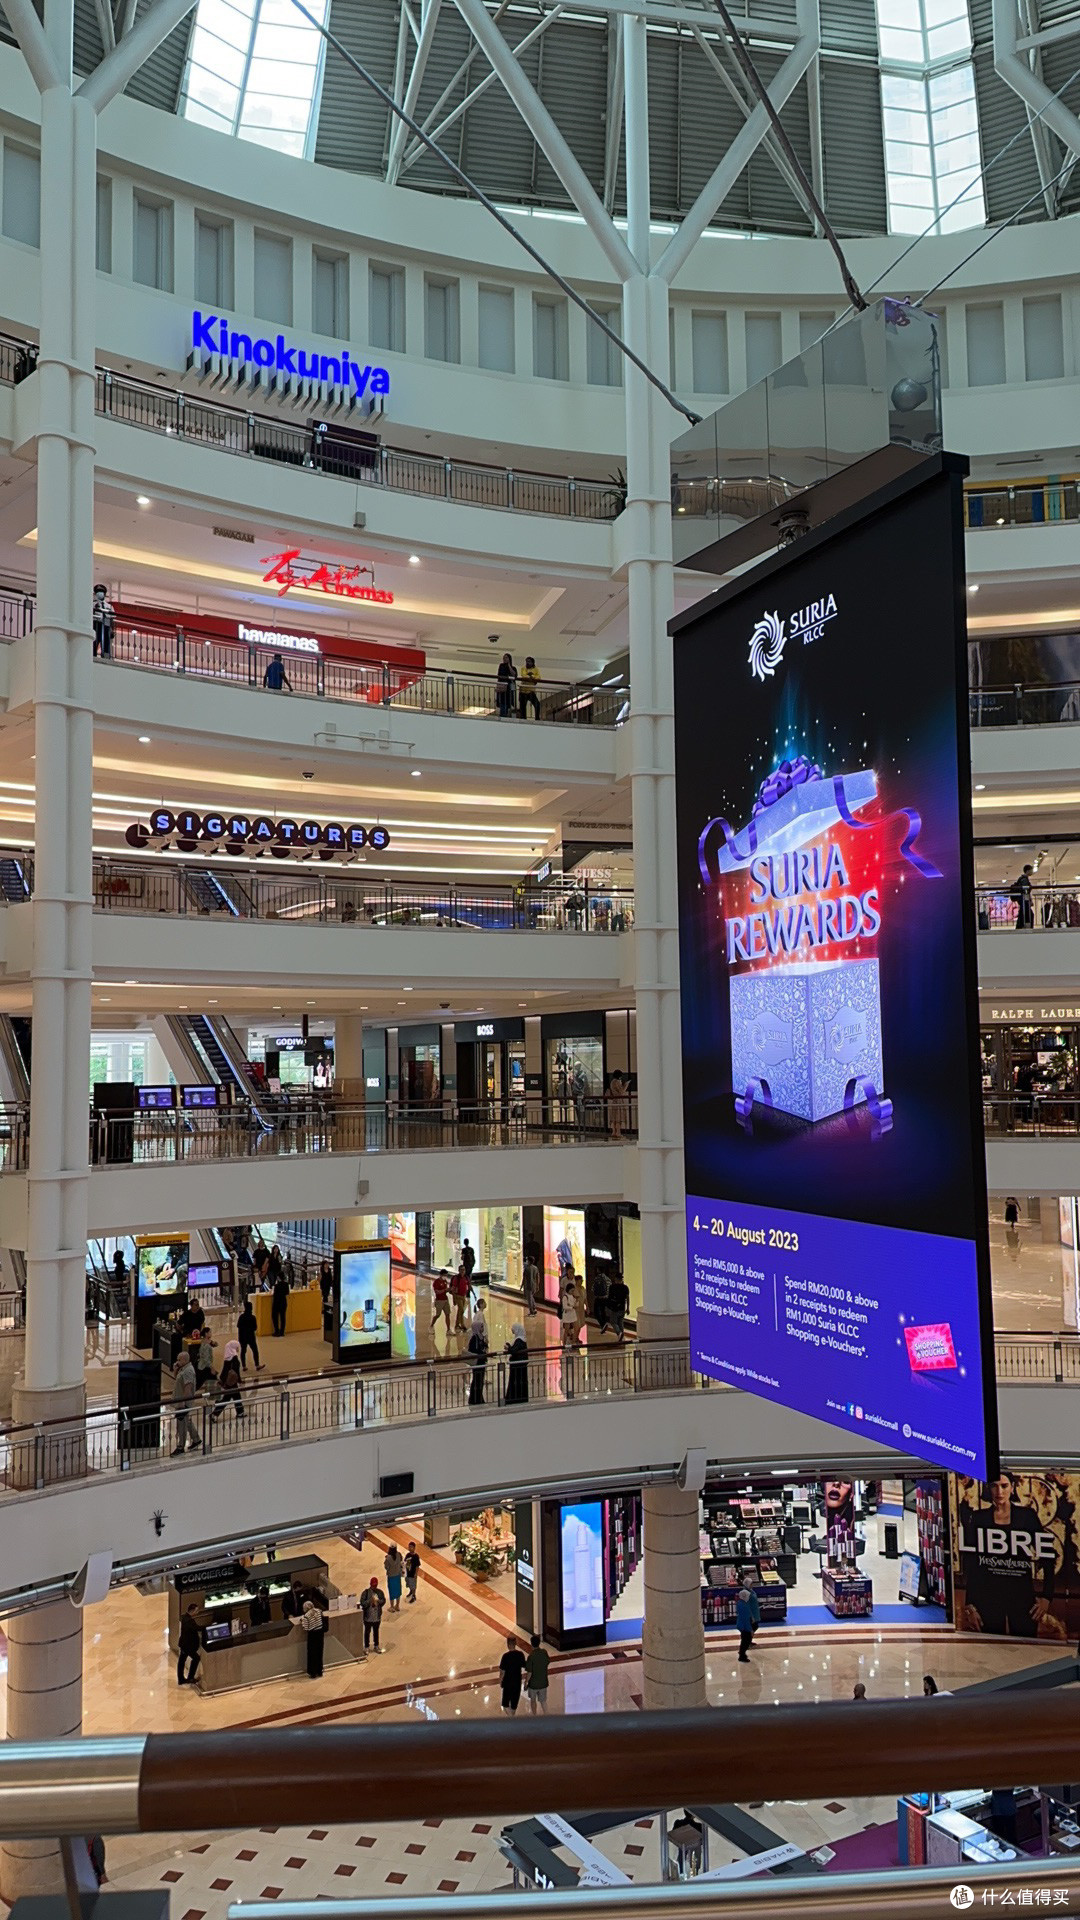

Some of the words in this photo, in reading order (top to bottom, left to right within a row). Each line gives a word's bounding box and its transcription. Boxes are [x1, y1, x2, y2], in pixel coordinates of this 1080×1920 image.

[193, 311, 389, 398] Kinokuniya
[213, 526, 255, 544] PAWAGAM
[790, 593, 838, 634] SURIA
[238, 623, 320, 652] havaianas
[803, 624, 825, 645] KLCC
[156, 814, 385, 846] SIGNATURES
[574, 867, 613, 879] GUESS
[750, 843, 851, 905] SURIA
[725, 889, 882, 965] REWARDS
[991, 1009, 1034, 1019] RALPH
[476, 1024, 494, 1036] BOSS
[693, 1215, 701, 1232] 4
[710, 1218, 725, 1237] 20
[727, 1221, 766, 1247] August
[769, 1228, 799, 1252] 2023
[694, 1254, 712, 1267] Spend
[713, 1258, 739, 1274] RM5,000
[739, 1265, 745, 1276] &
[746, 1267, 765, 1280] above
[694, 1268, 700, 1278] in
[701, 1270, 705, 1280] 2
[706, 1274, 729, 1287] receipts
[729, 1279, 736, 1288] to
[737, 1281, 760, 1294] redeem
[695, 1282, 715, 1297] RM300
[716, 1288, 730, 1301] Suria
[731, 1292, 748, 1306] KLCC
[784, 1276, 807, 1291] Spend
[808, 1281, 845, 1301] RM20,000
[846, 1291, 853, 1303] &
[854, 1293, 879, 1309] above
[695, 1297, 722, 1316] Shopping
[785, 1291, 792, 1303] in
[793, 1294, 798, 1305] 2
[799, 1299, 827, 1313] receipts
[828, 1304, 836, 1315] to
[838, 1307, 868, 1324] redeem
[786, 1307, 817, 1326] RM1,000
[818, 1316, 836, 1332] Suria
[837, 1321, 860, 1339] KLCC
[786, 1323, 820, 1346] Shopping
[915, 1340, 944, 1350] SHOPPING
[715, 1357, 735, 1371] Conditions
[826, 1399, 836, 1408] Join
[865, 1413, 899, 1431] suriaklccmall
[912, 1430, 977, 1461] www.suriaklcc.com.my
[958, 1525, 1056, 1559] LIBRE
[181, 1566, 234, 1585] CONCIERGE
[753, 1848, 787, 1867] HABIB
